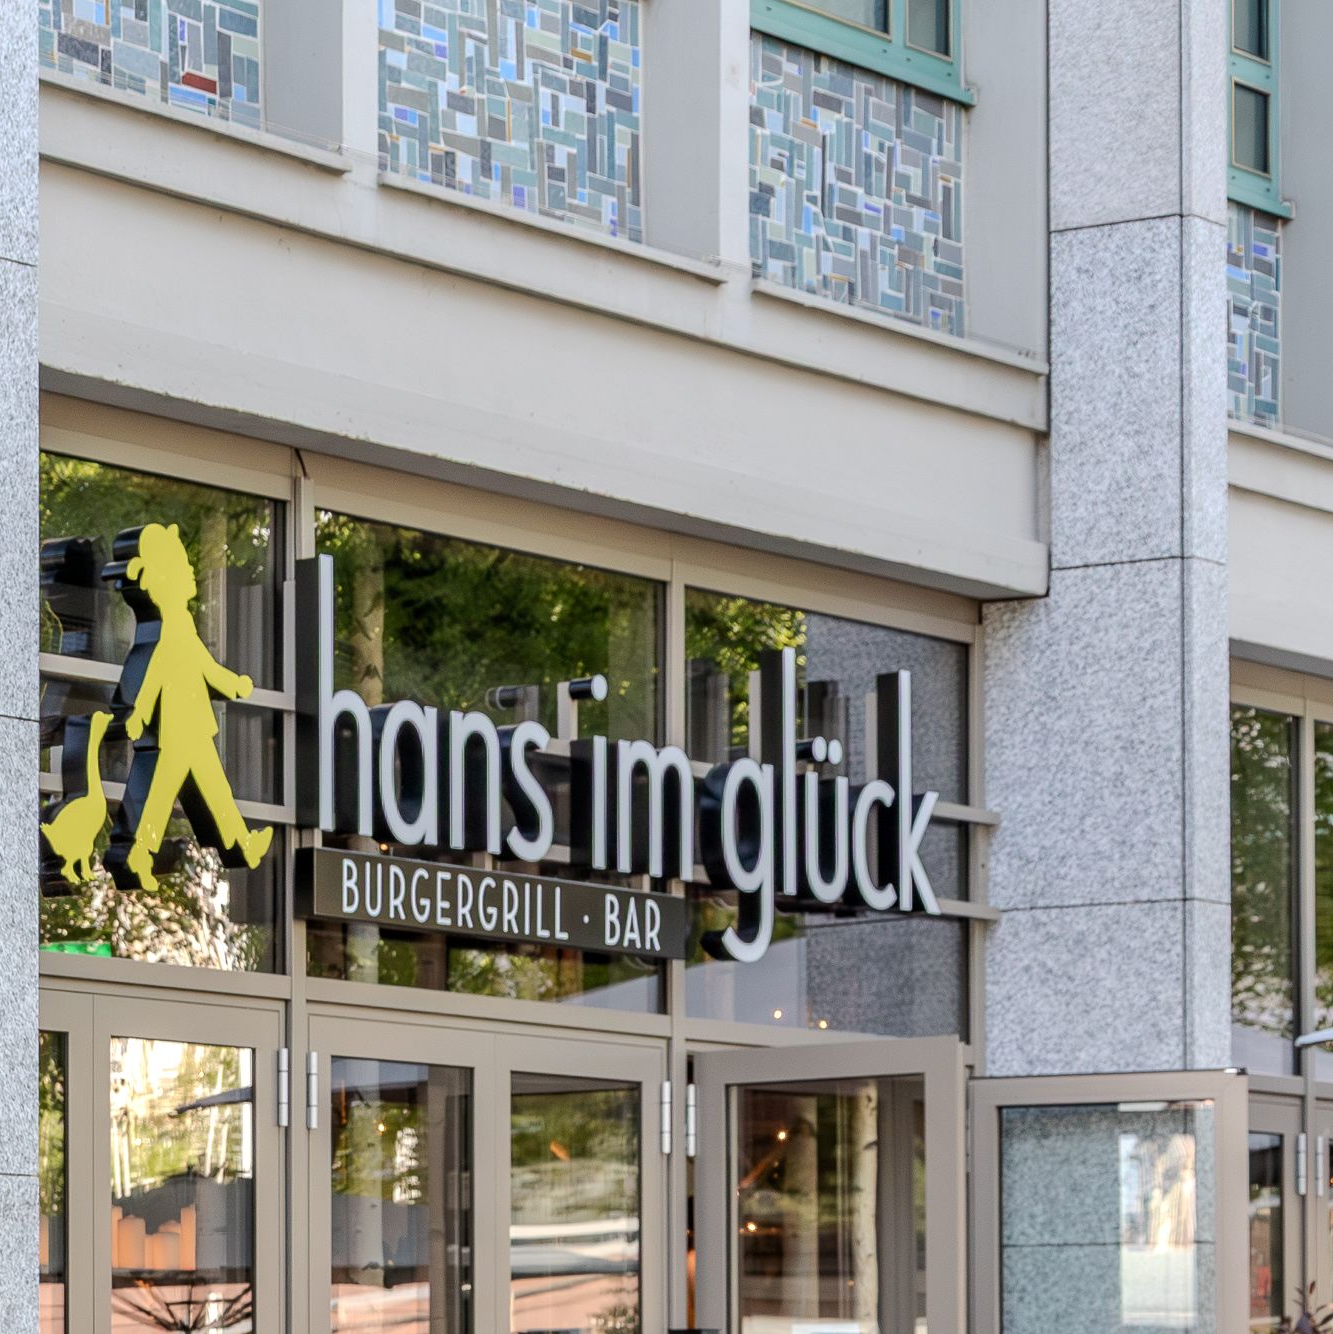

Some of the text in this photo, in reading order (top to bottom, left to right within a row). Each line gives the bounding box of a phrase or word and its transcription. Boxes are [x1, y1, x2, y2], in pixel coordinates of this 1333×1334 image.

[319, 553, 941, 964] hans im glück
[341, 857, 662, 954] BURGERGRILL BAR
